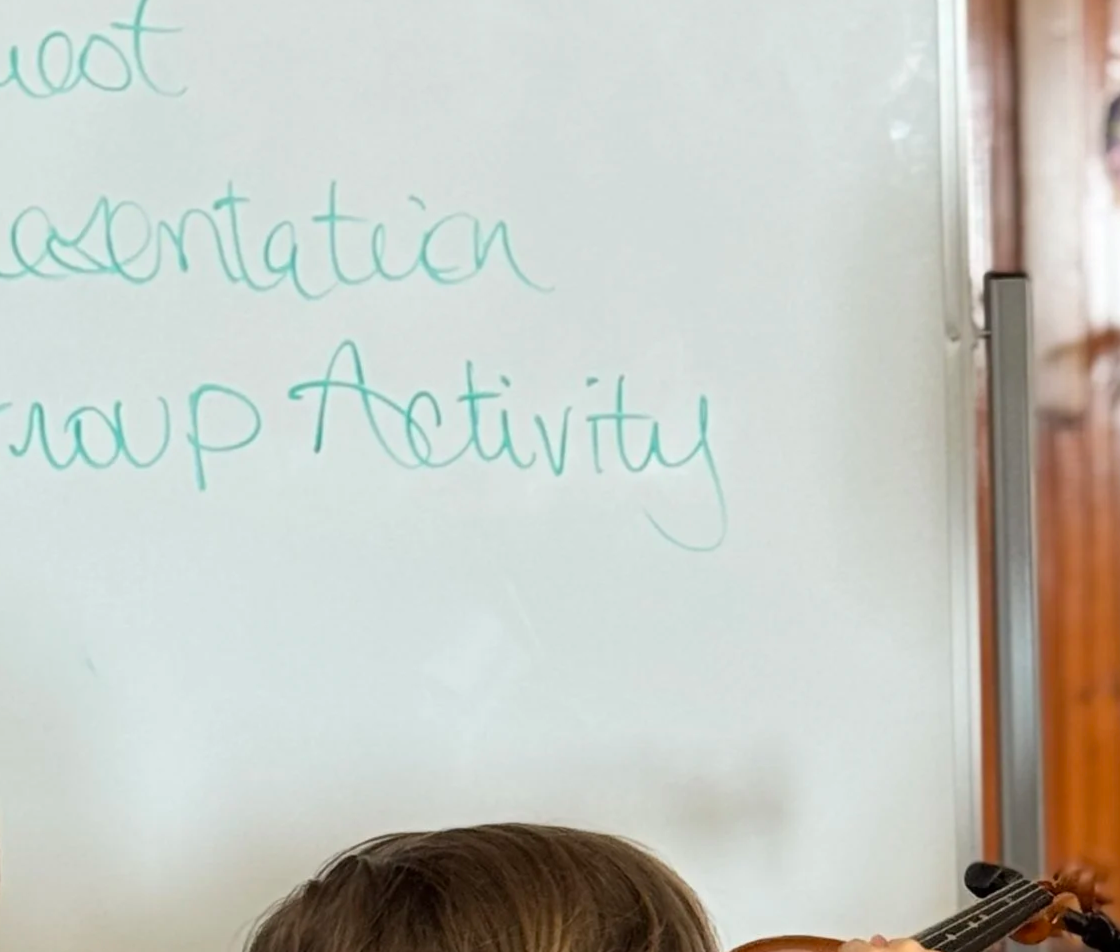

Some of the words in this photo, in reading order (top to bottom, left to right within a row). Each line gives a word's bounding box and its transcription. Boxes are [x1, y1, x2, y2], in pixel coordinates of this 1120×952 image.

[0, 179, 556, 301] esentation
[0, 381, 263, 492] roup
[287, 338, 728, 552] Activity
